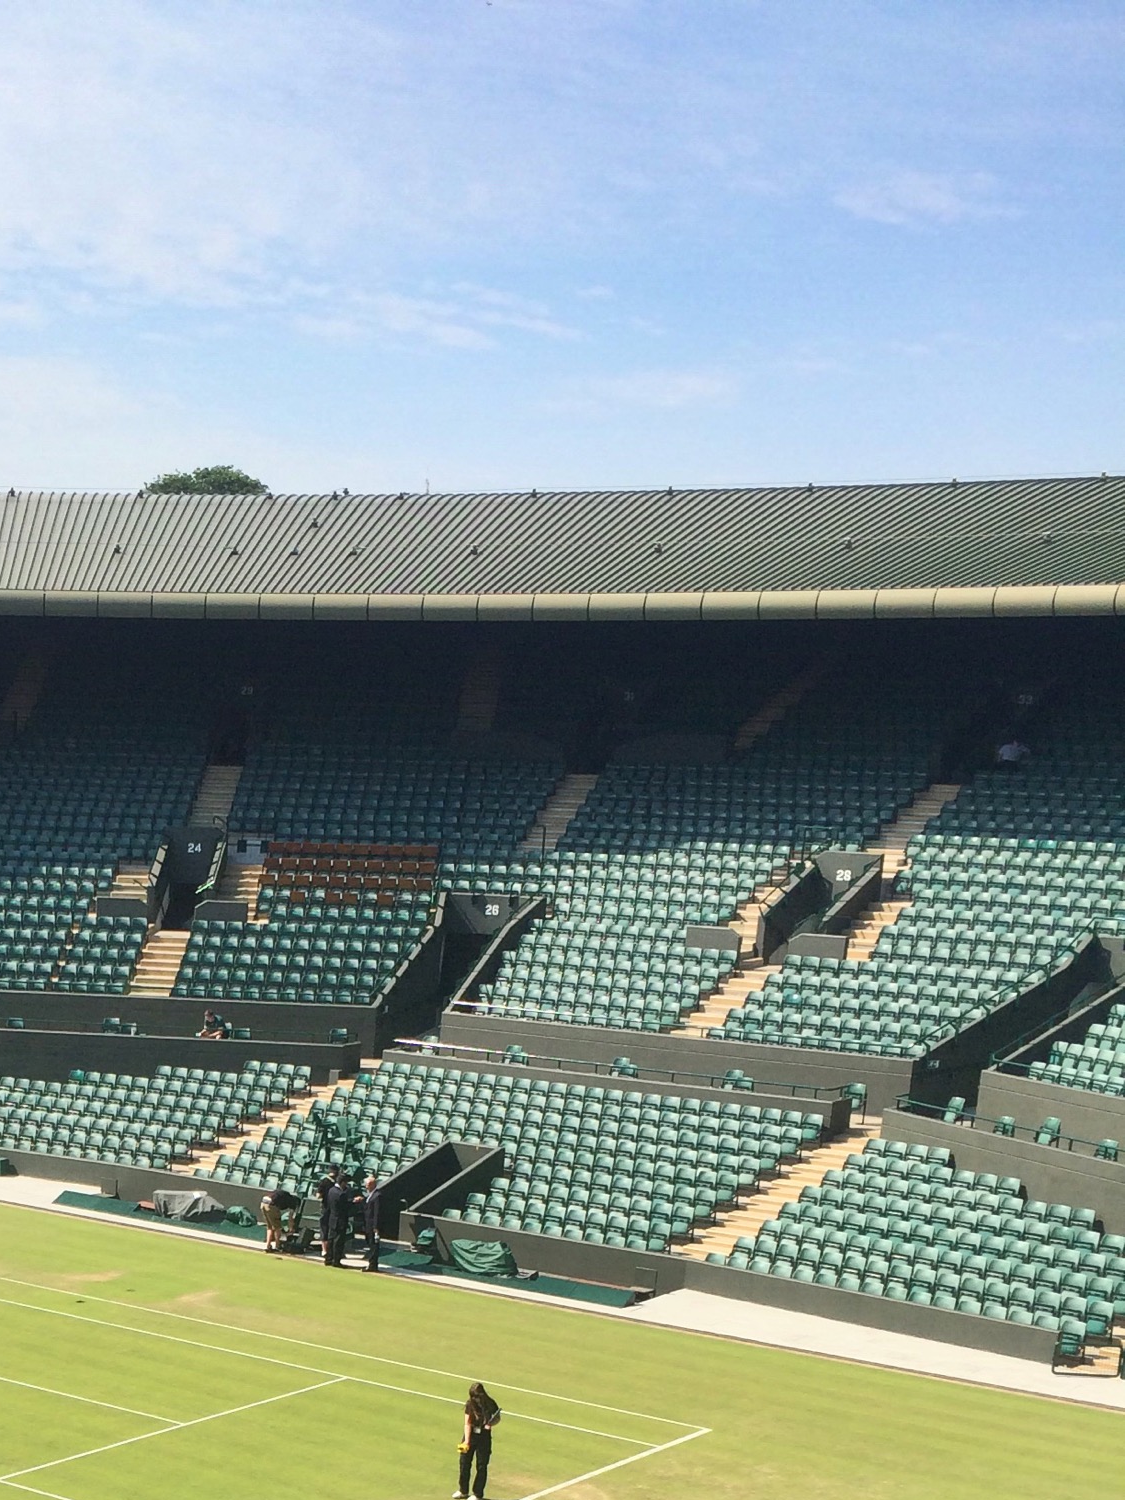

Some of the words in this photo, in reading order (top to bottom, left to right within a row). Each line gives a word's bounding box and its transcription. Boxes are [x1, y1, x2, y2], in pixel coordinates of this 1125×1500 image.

[187, 843, 202, 853] 24
[835, 869, 852, 881] 28
[484, 904, 500, 916] 26
